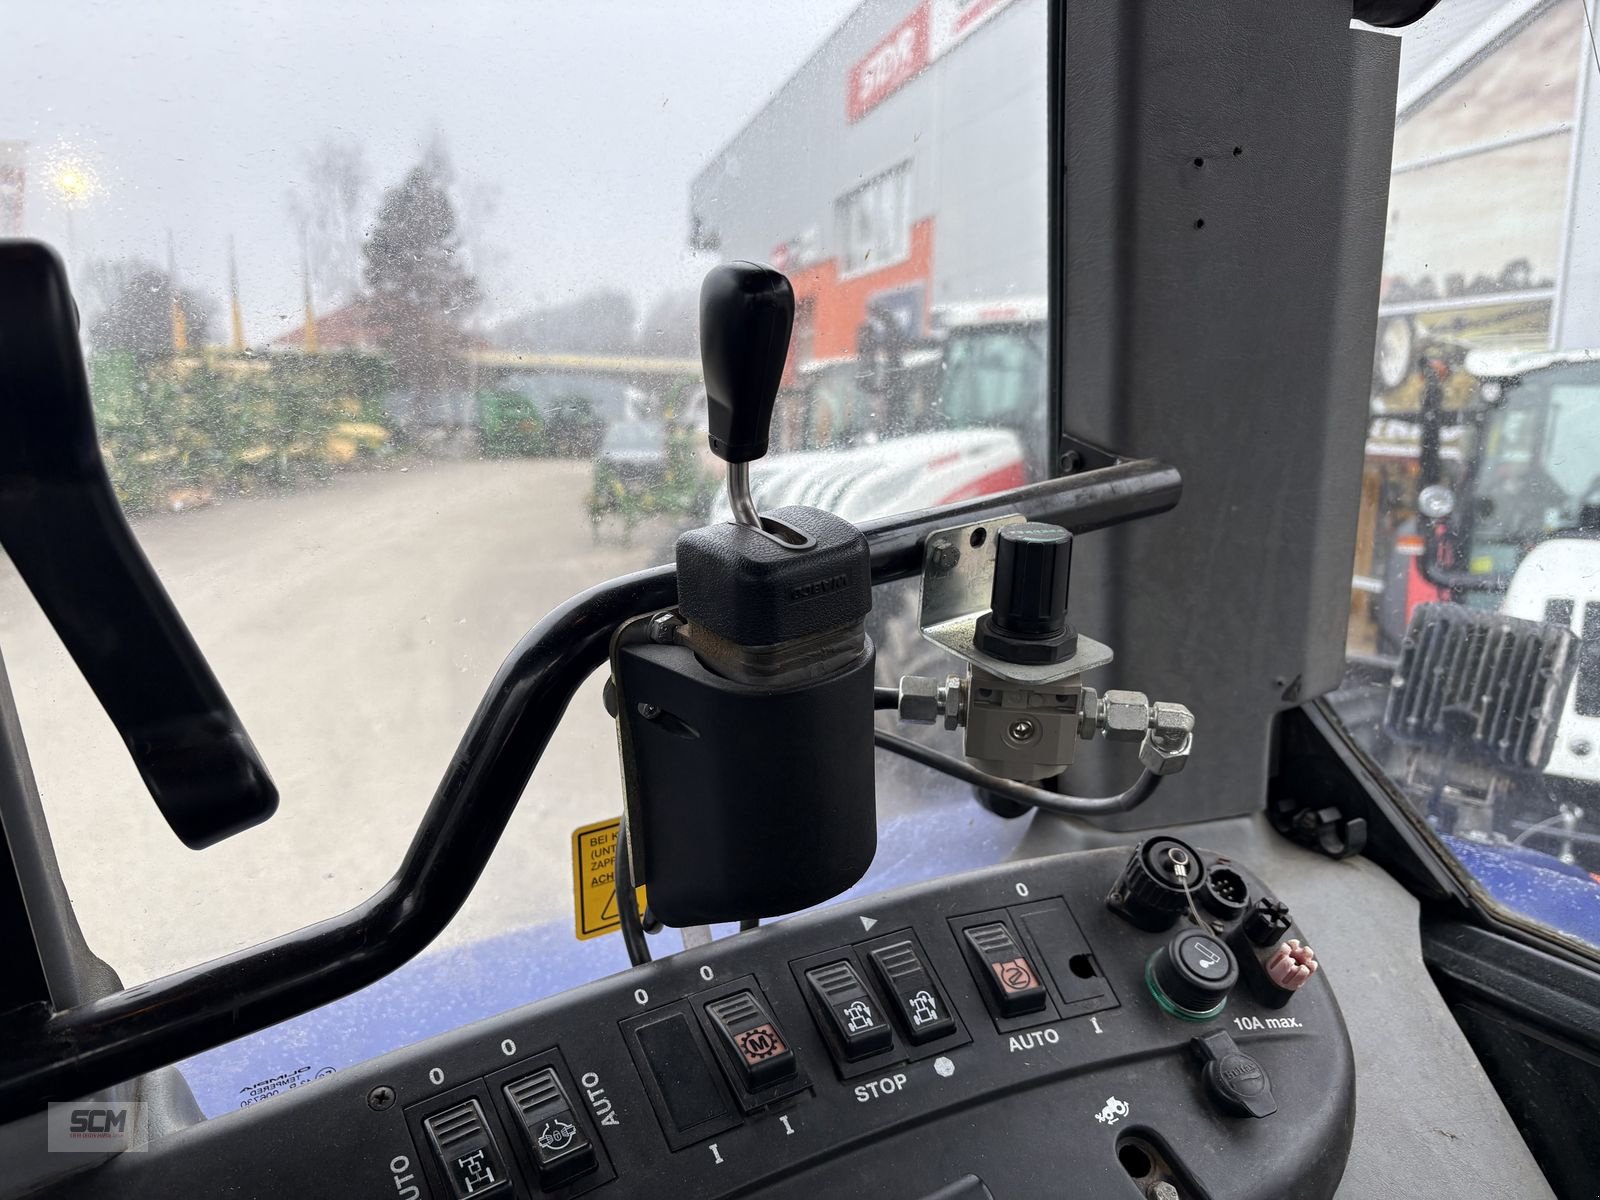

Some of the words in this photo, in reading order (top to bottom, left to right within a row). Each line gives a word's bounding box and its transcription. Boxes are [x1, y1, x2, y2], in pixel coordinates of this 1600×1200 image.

[590, 834, 608, 848] BEI
[1233, 1016, 1264, 1030] 10A
[1265, 1017, 1303, 1028] max.
[1008, 1027, 1060, 1052] AUTO
[581, 1071, 620, 1128] AUTO
[854, 1073, 907, 1102] STOP
[390, 1155, 422, 1200] UTO
